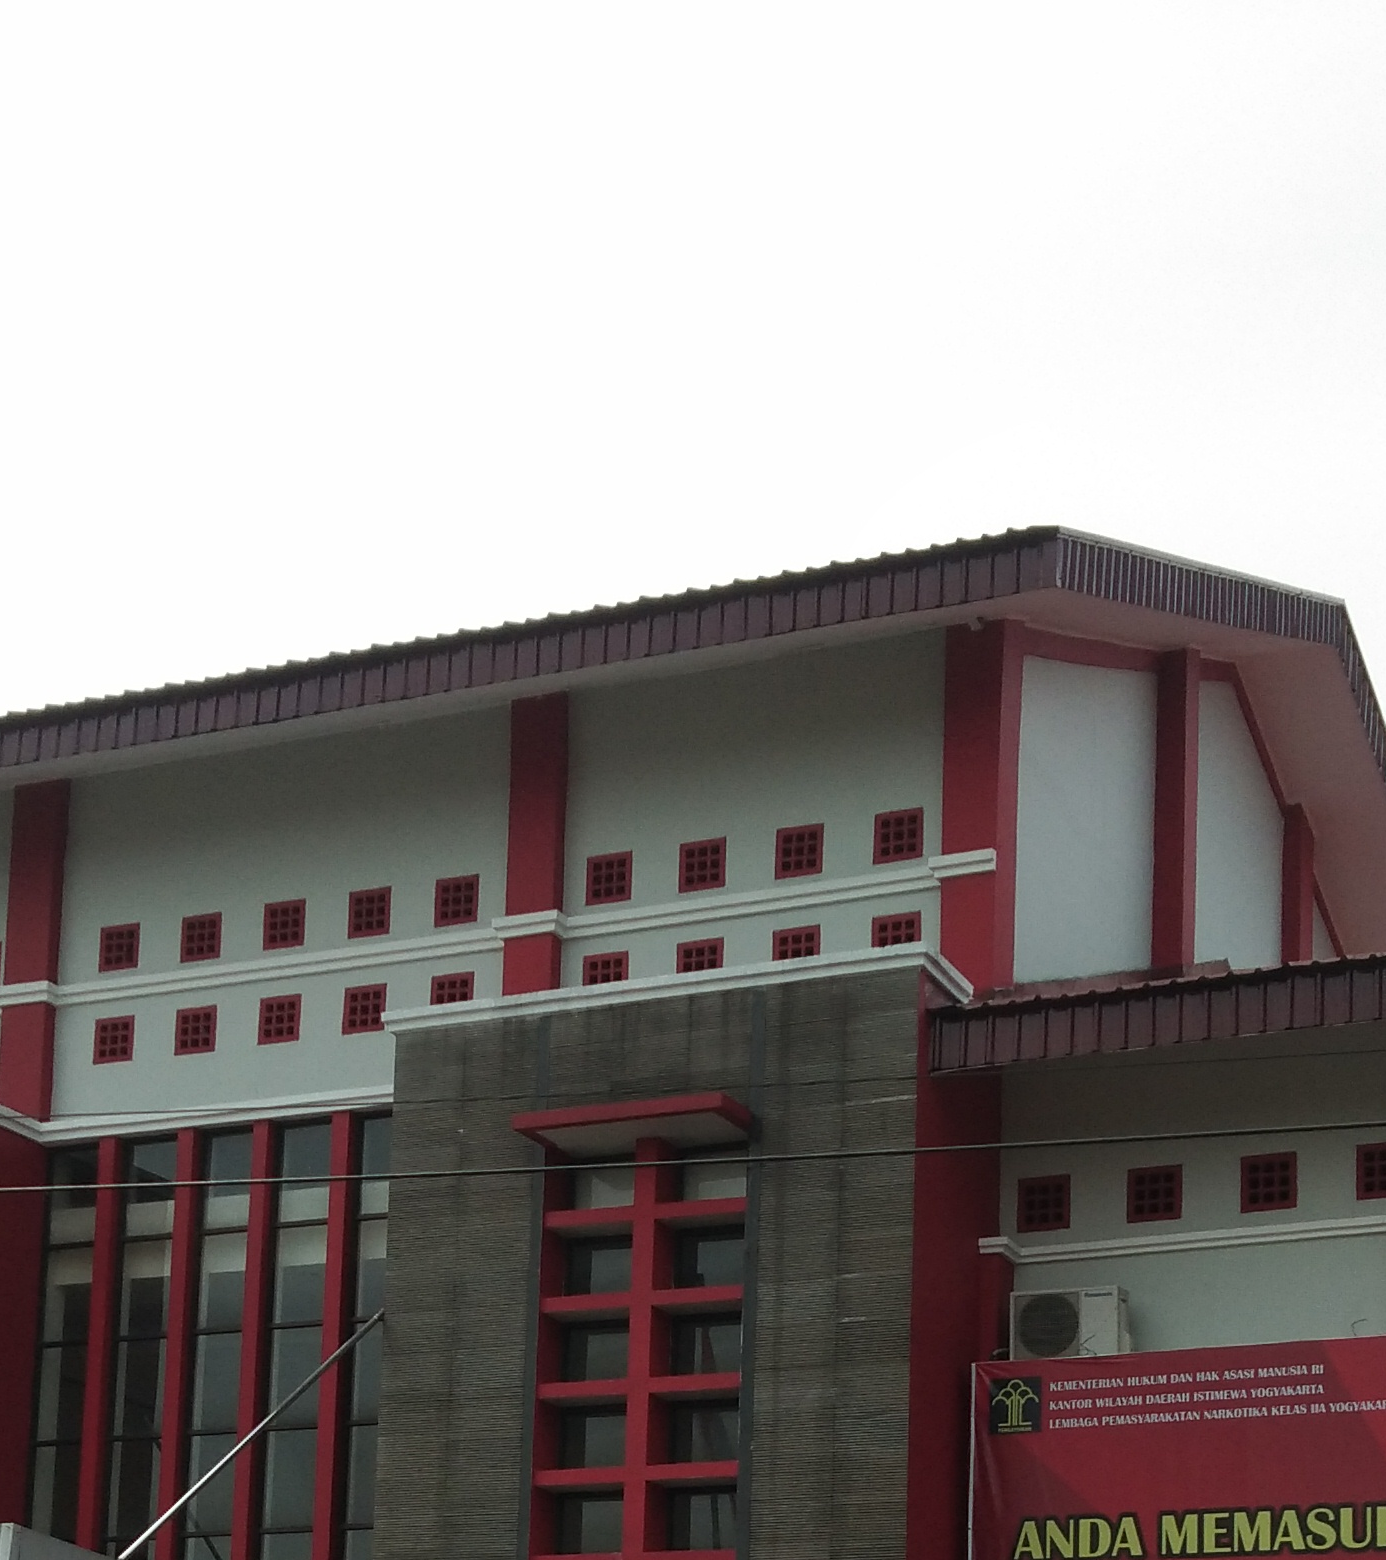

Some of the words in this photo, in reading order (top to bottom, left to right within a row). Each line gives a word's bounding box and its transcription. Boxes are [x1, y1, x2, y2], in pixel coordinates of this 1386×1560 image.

[1049, 1378, 1124, 1391] KEMENTERIAN
[1127, 1375, 1167, 1387] HUKUM
[1171, 1373, 1193, 1384] DAN
[1197, 1370, 1220, 1382] HAK
[1223, 1368, 1255, 1380] ASASI
[1258, 1365, 1308, 1378] MANUSIA
[1311, 1364, 1325, 1375] RI
[1049, 1398, 1092, 1411] KANTOR
[1095, 1395, 1143, 1408] WILAYAH
[1146, 1392, 1190, 1405] DAERAH
[1193, 1389, 1248, 1402] ISTIMEWA
[1250, 1384, 1325, 1399] YOGYAKARTA
[1049, 1416, 1099, 1429] LEMBAGA
[1102, 1410, 1201, 1426] PEMASYARAKATAN
[1204, 1404, 1268, 1420] NARKOTIKA
[1271, 1403, 1307, 1416] KELAS
[1310, 1402, 1327, 1414] IIA
[1013, 1516, 1144, 1560] ANDA
